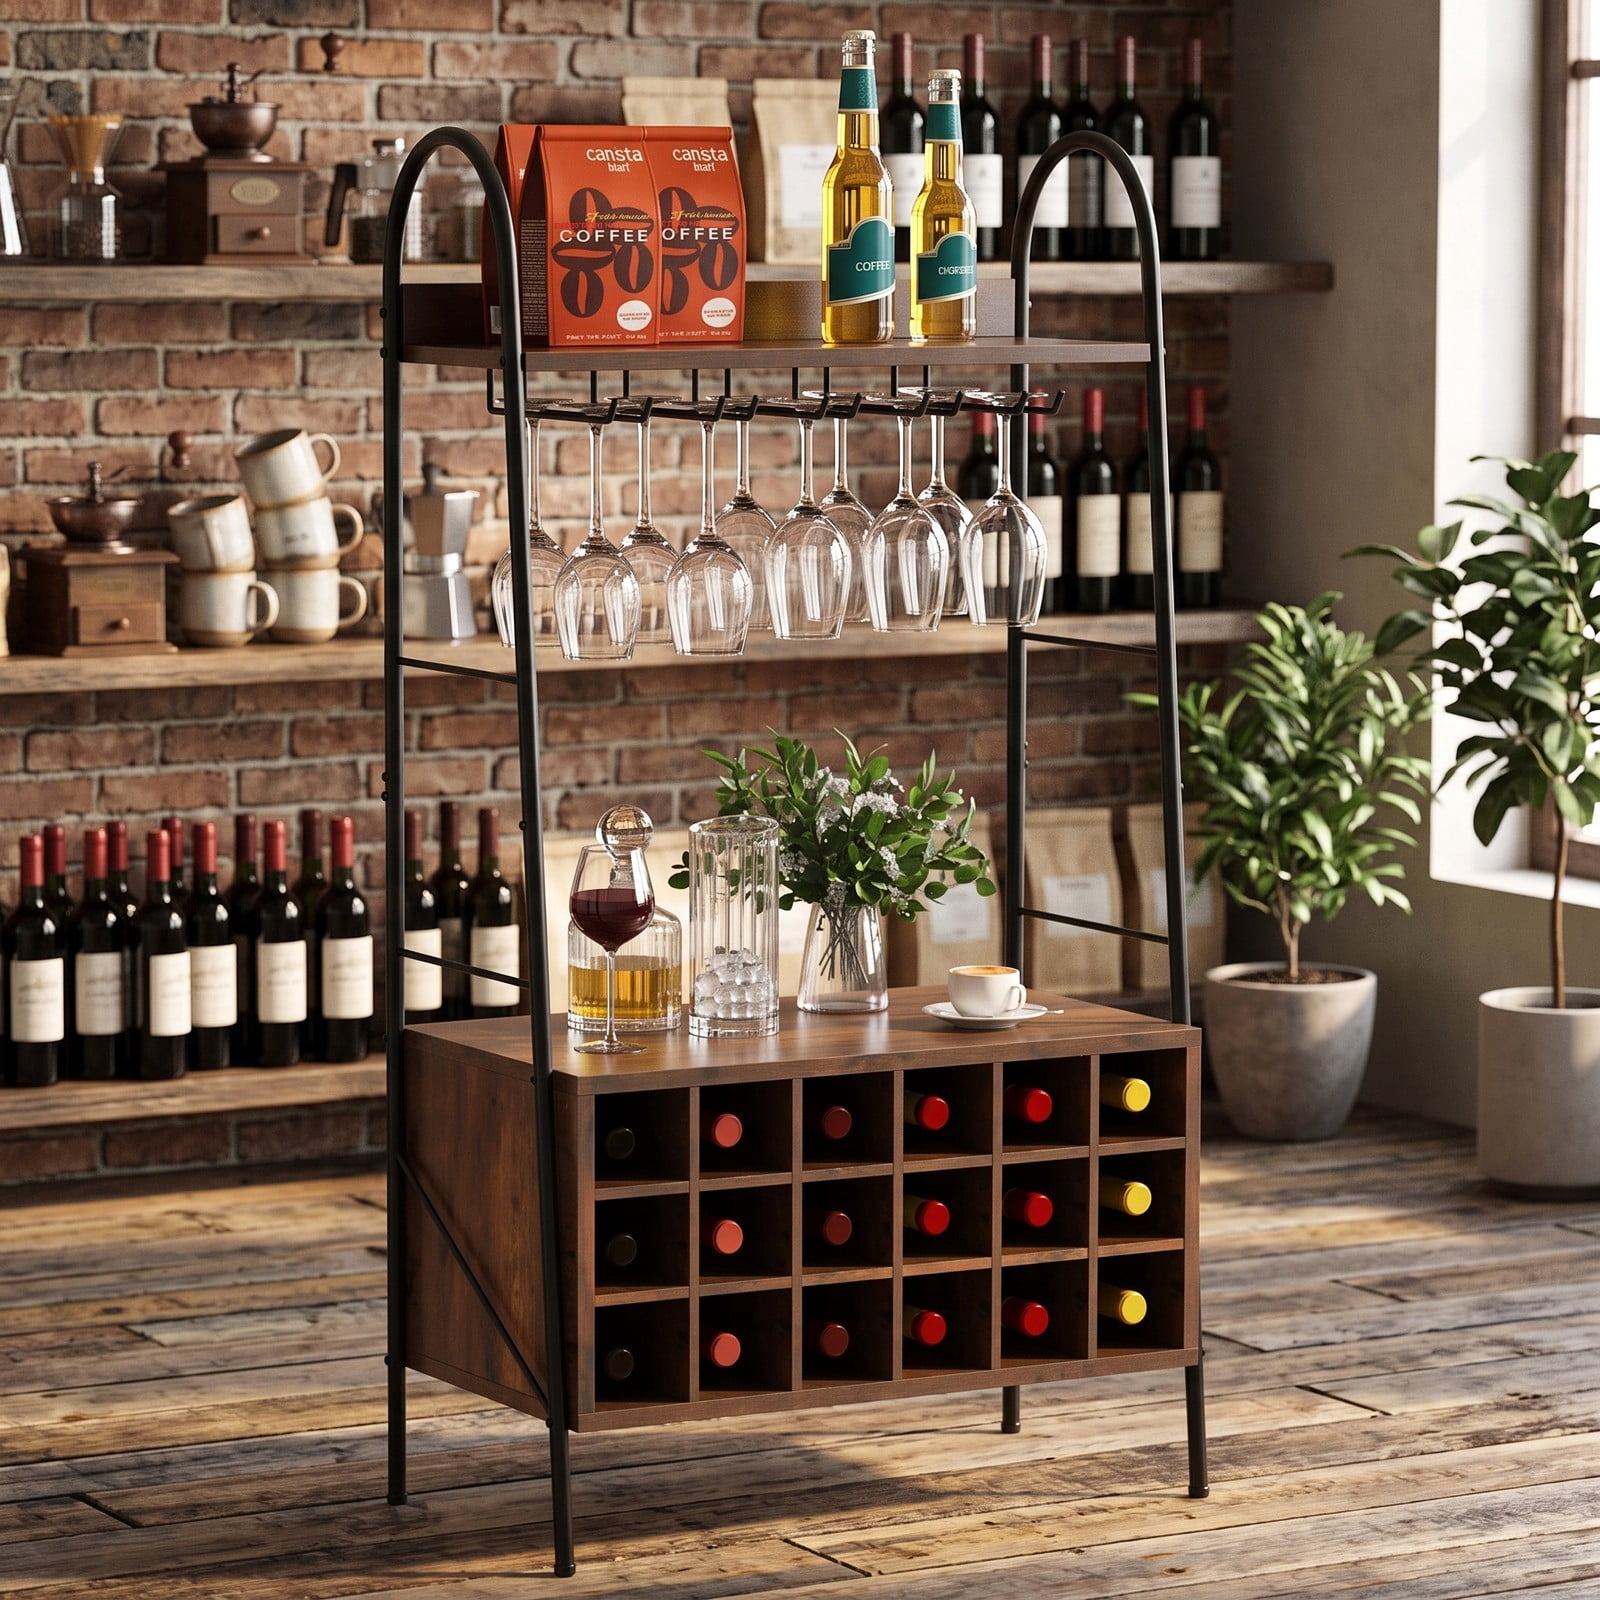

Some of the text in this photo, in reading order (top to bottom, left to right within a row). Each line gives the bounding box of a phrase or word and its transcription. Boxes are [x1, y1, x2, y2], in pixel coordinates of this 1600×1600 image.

[559, 229, 648, 242] COFFEE
[662, 227, 733, 240] OFFEE
[855, 260, 890, 272] COFFEE
